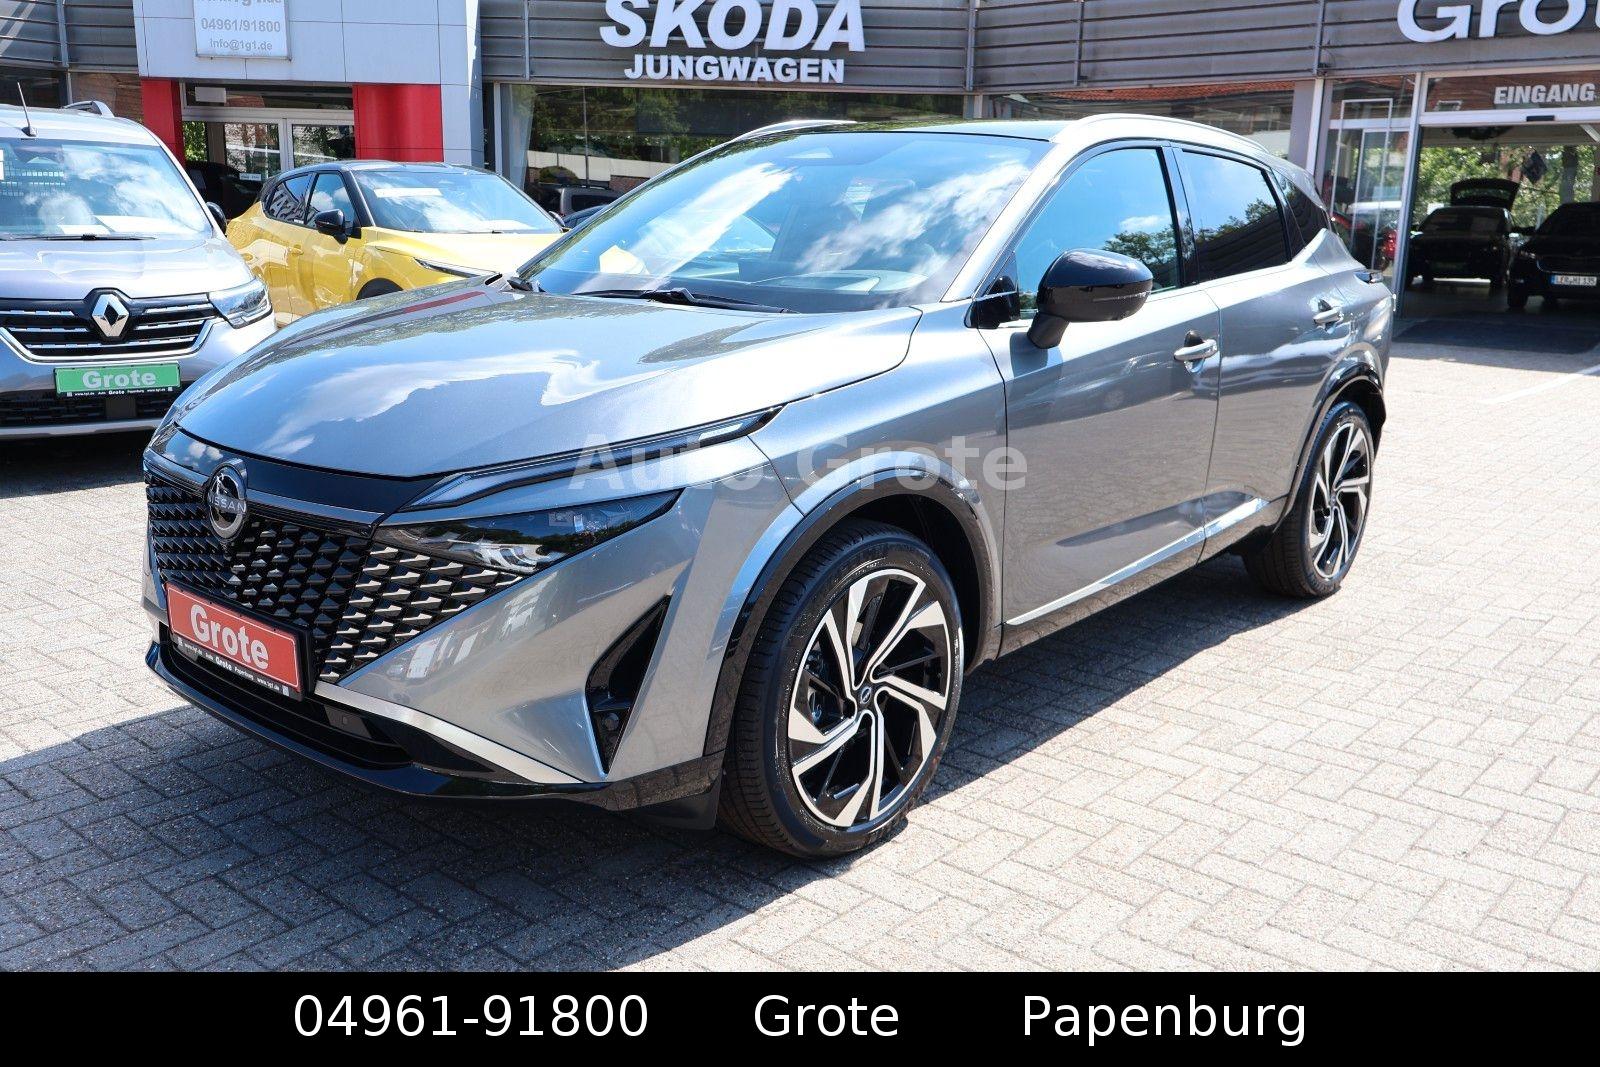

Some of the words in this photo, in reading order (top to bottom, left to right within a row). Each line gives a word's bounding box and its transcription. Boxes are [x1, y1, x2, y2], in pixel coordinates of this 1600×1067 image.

[201, 17, 281, 33] 04961/91800
[1397, 0, 1600, 43] Gro
[624, 54, 844, 83] JUNGWAGEN
[1494, 83, 1596, 104] EINGANG
[82, 369, 156, 389] Grote
[190, 604, 269, 670] Grote
[215, 656, 232, 671] Grote
